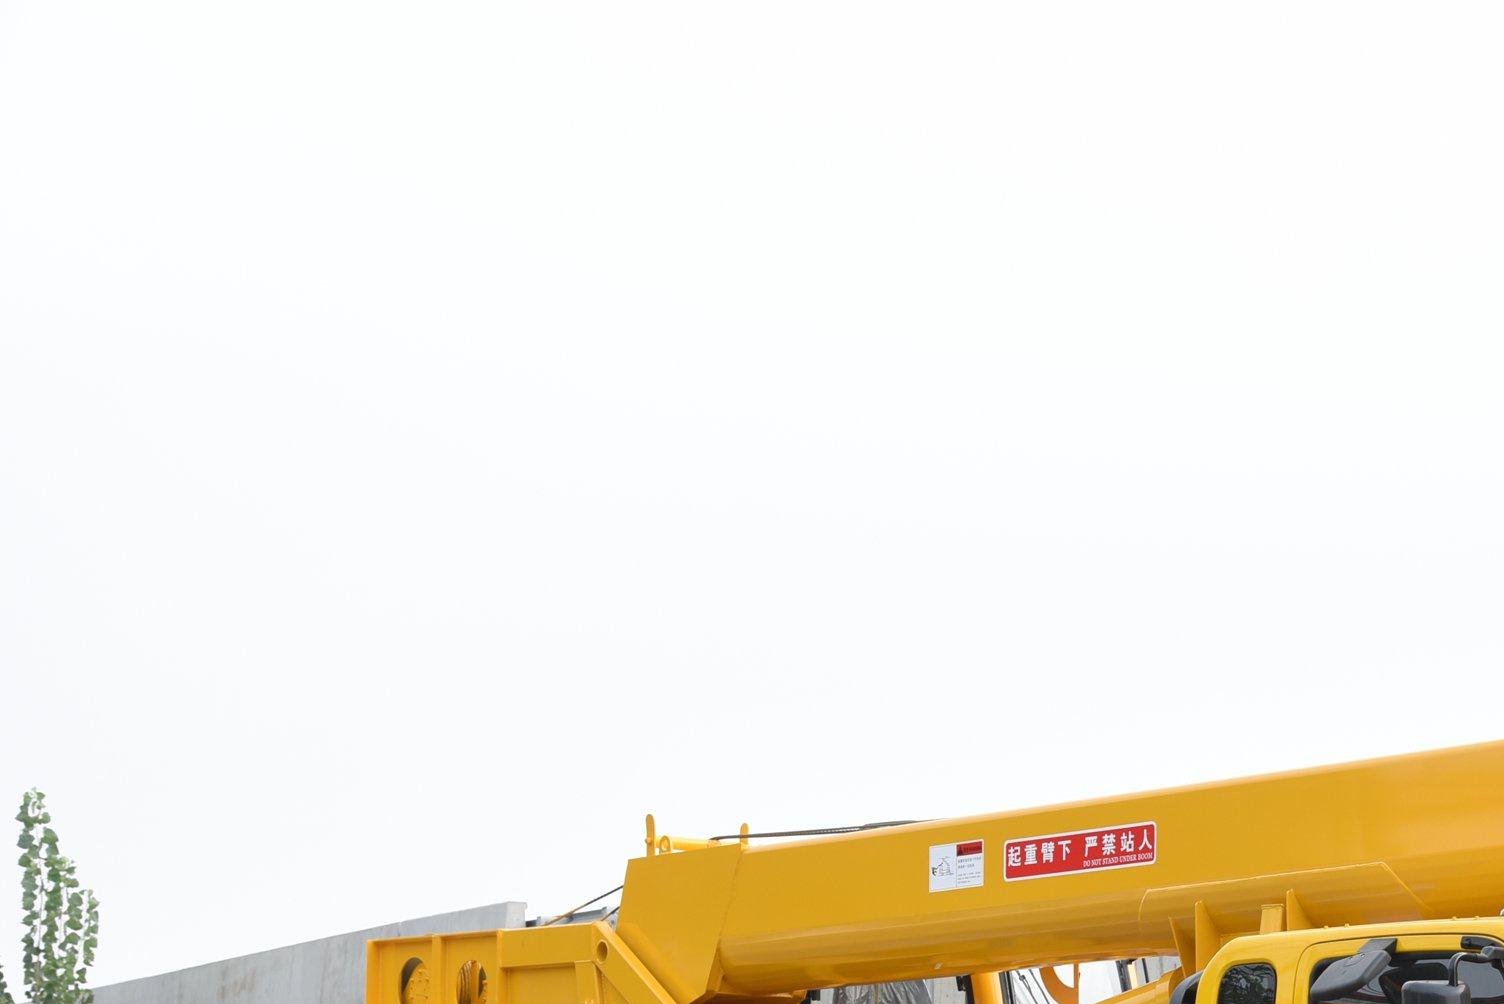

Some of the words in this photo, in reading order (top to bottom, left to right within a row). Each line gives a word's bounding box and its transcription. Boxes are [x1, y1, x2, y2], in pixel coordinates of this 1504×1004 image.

[1008, 840, 1071, 867] 起重臂下
[1085, 829, 1152, 857] 严禁站人
[1102, 857, 1118, 865] STAND
[1120, 854, 1137, 862] UNDER
